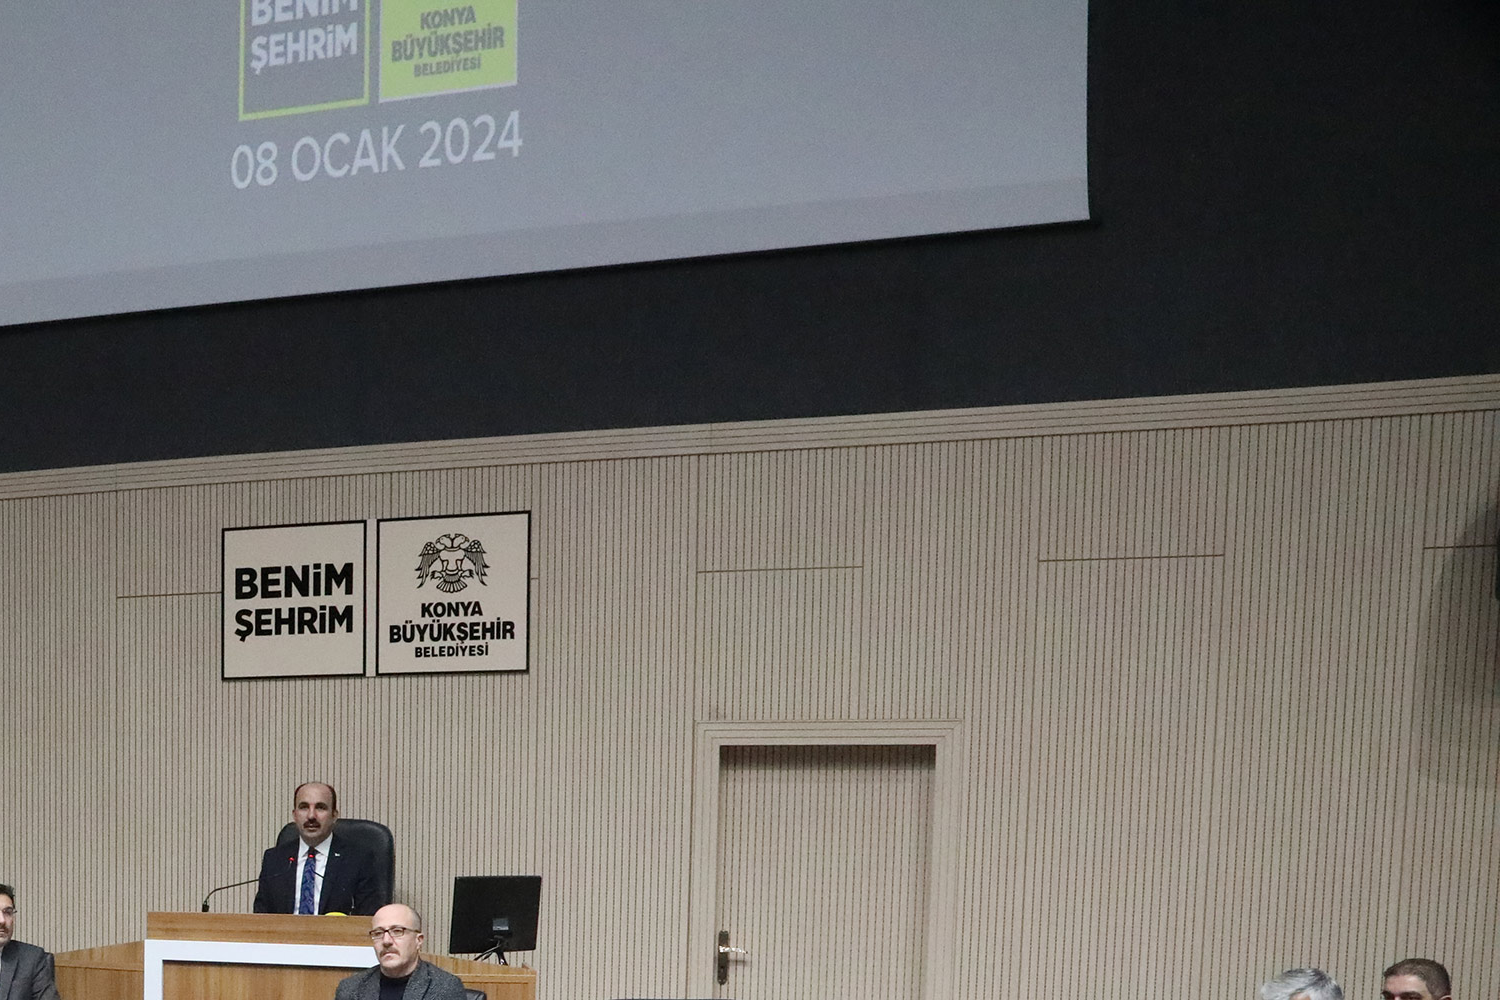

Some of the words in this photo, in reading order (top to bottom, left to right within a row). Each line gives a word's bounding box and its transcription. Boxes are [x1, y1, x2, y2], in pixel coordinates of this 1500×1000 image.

[420, 5, 476, 30] KONYA
[231, 141, 279, 189] 08
[291, 123, 406, 182] OCAK
[418, 110, 524, 168] 2024
[421, 601, 483, 618] KONYA
[389, 617, 515, 644] BÜYÜKŞEHİR
[414, 642, 489, 658] BELEDİYESİ
